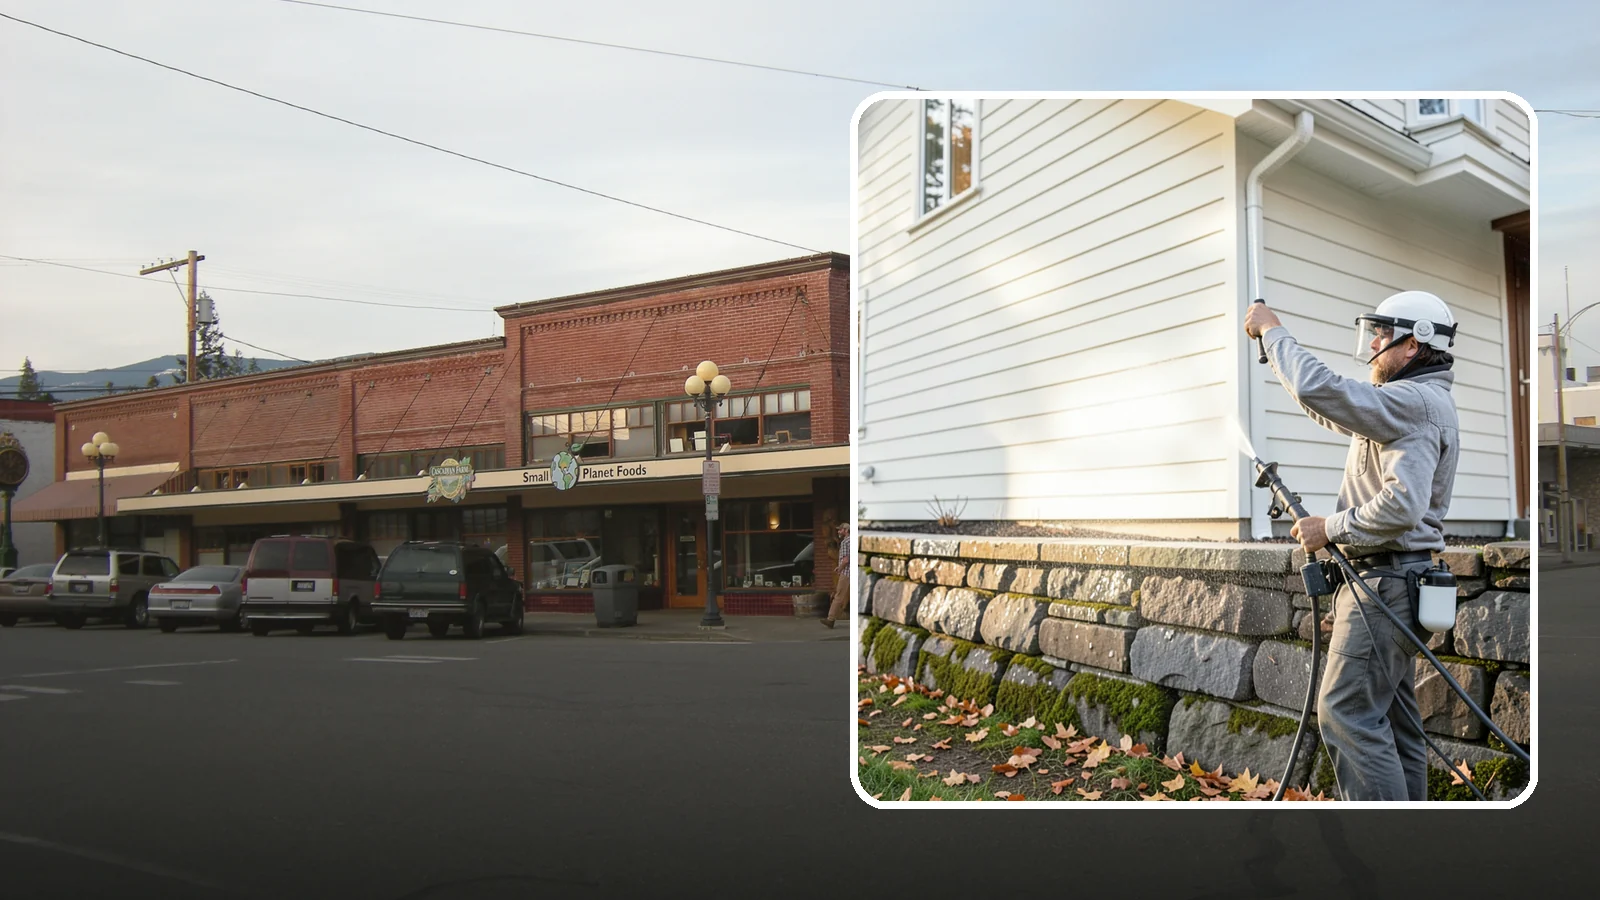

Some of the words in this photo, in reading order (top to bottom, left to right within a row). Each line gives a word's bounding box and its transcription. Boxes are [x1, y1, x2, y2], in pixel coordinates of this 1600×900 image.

[523, 471, 549, 483] Small
[583, 467, 614, 479] Planet
[617, 464, 647, 477] Foods
